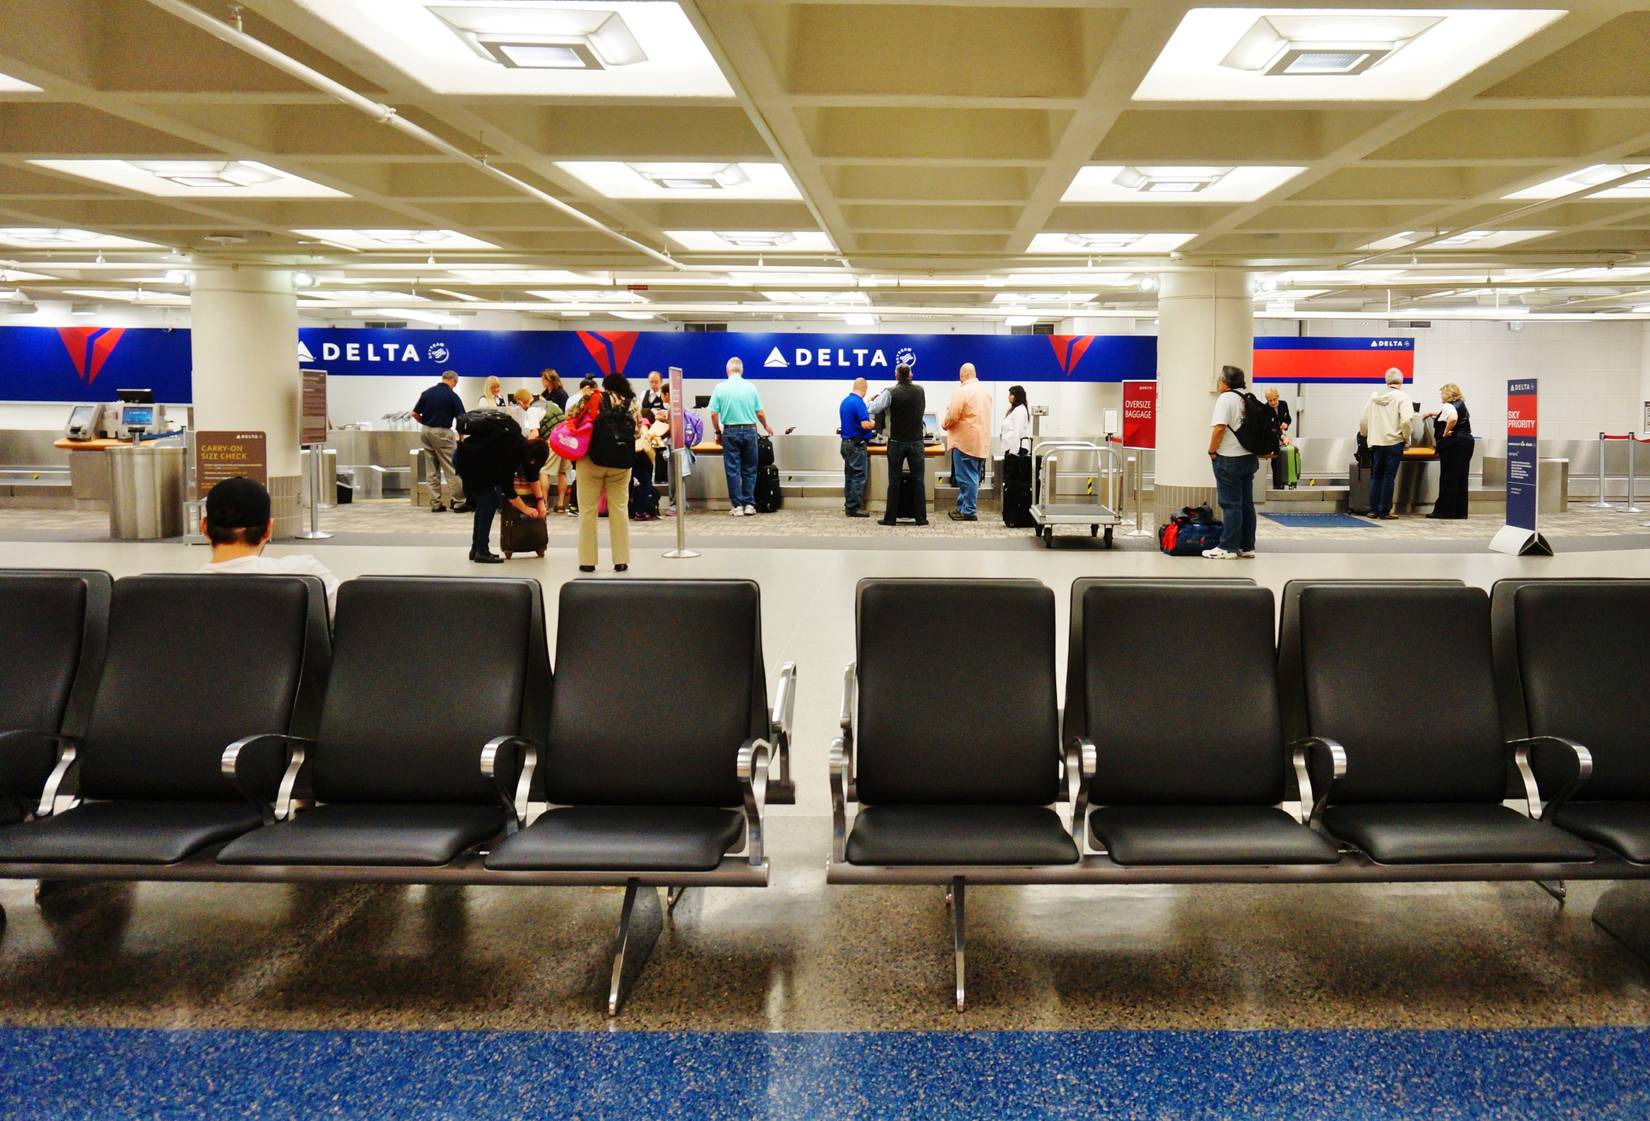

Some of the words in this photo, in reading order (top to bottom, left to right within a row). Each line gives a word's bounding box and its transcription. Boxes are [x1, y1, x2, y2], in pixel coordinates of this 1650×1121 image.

[322, 342, 420, 362] DELTA
[795, 348, 888, 367] DELTA
[1514, 383, 1530, 391] DELTA
[1125, 400, 1152, 409] OVERSIZE
[1125, 410, 1152, 419] BAGGAGE
[1508, 410, 1520, 419] SKY
[1508, 420, 1536, 429] PRIORITY
[201, 444, 243, 452] CARRY-ON
